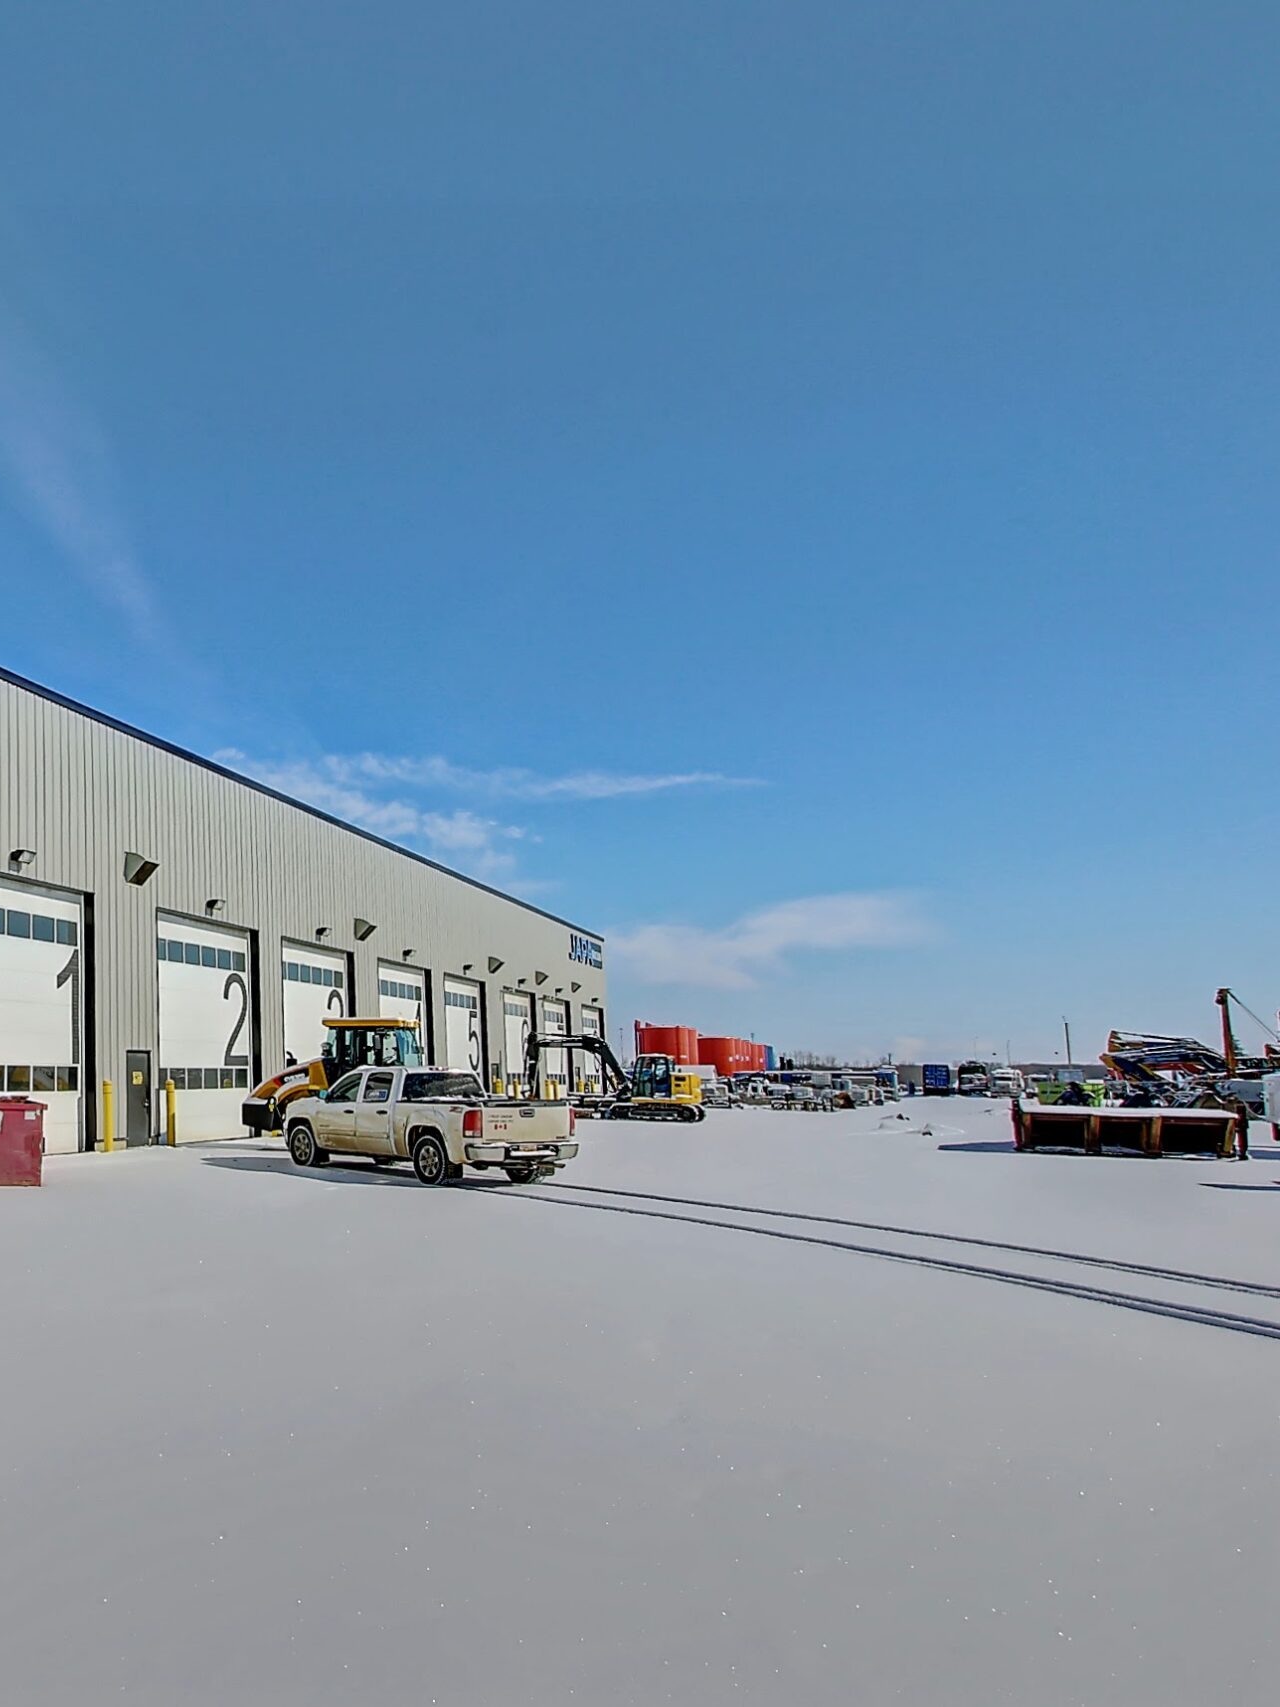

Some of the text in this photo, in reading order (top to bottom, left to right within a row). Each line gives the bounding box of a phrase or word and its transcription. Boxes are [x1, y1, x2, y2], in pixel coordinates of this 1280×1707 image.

[57, 949, 80, 1065] 1
[223, 973, 249, 1066] 2
[469, 1010, 480, 1071] 5
